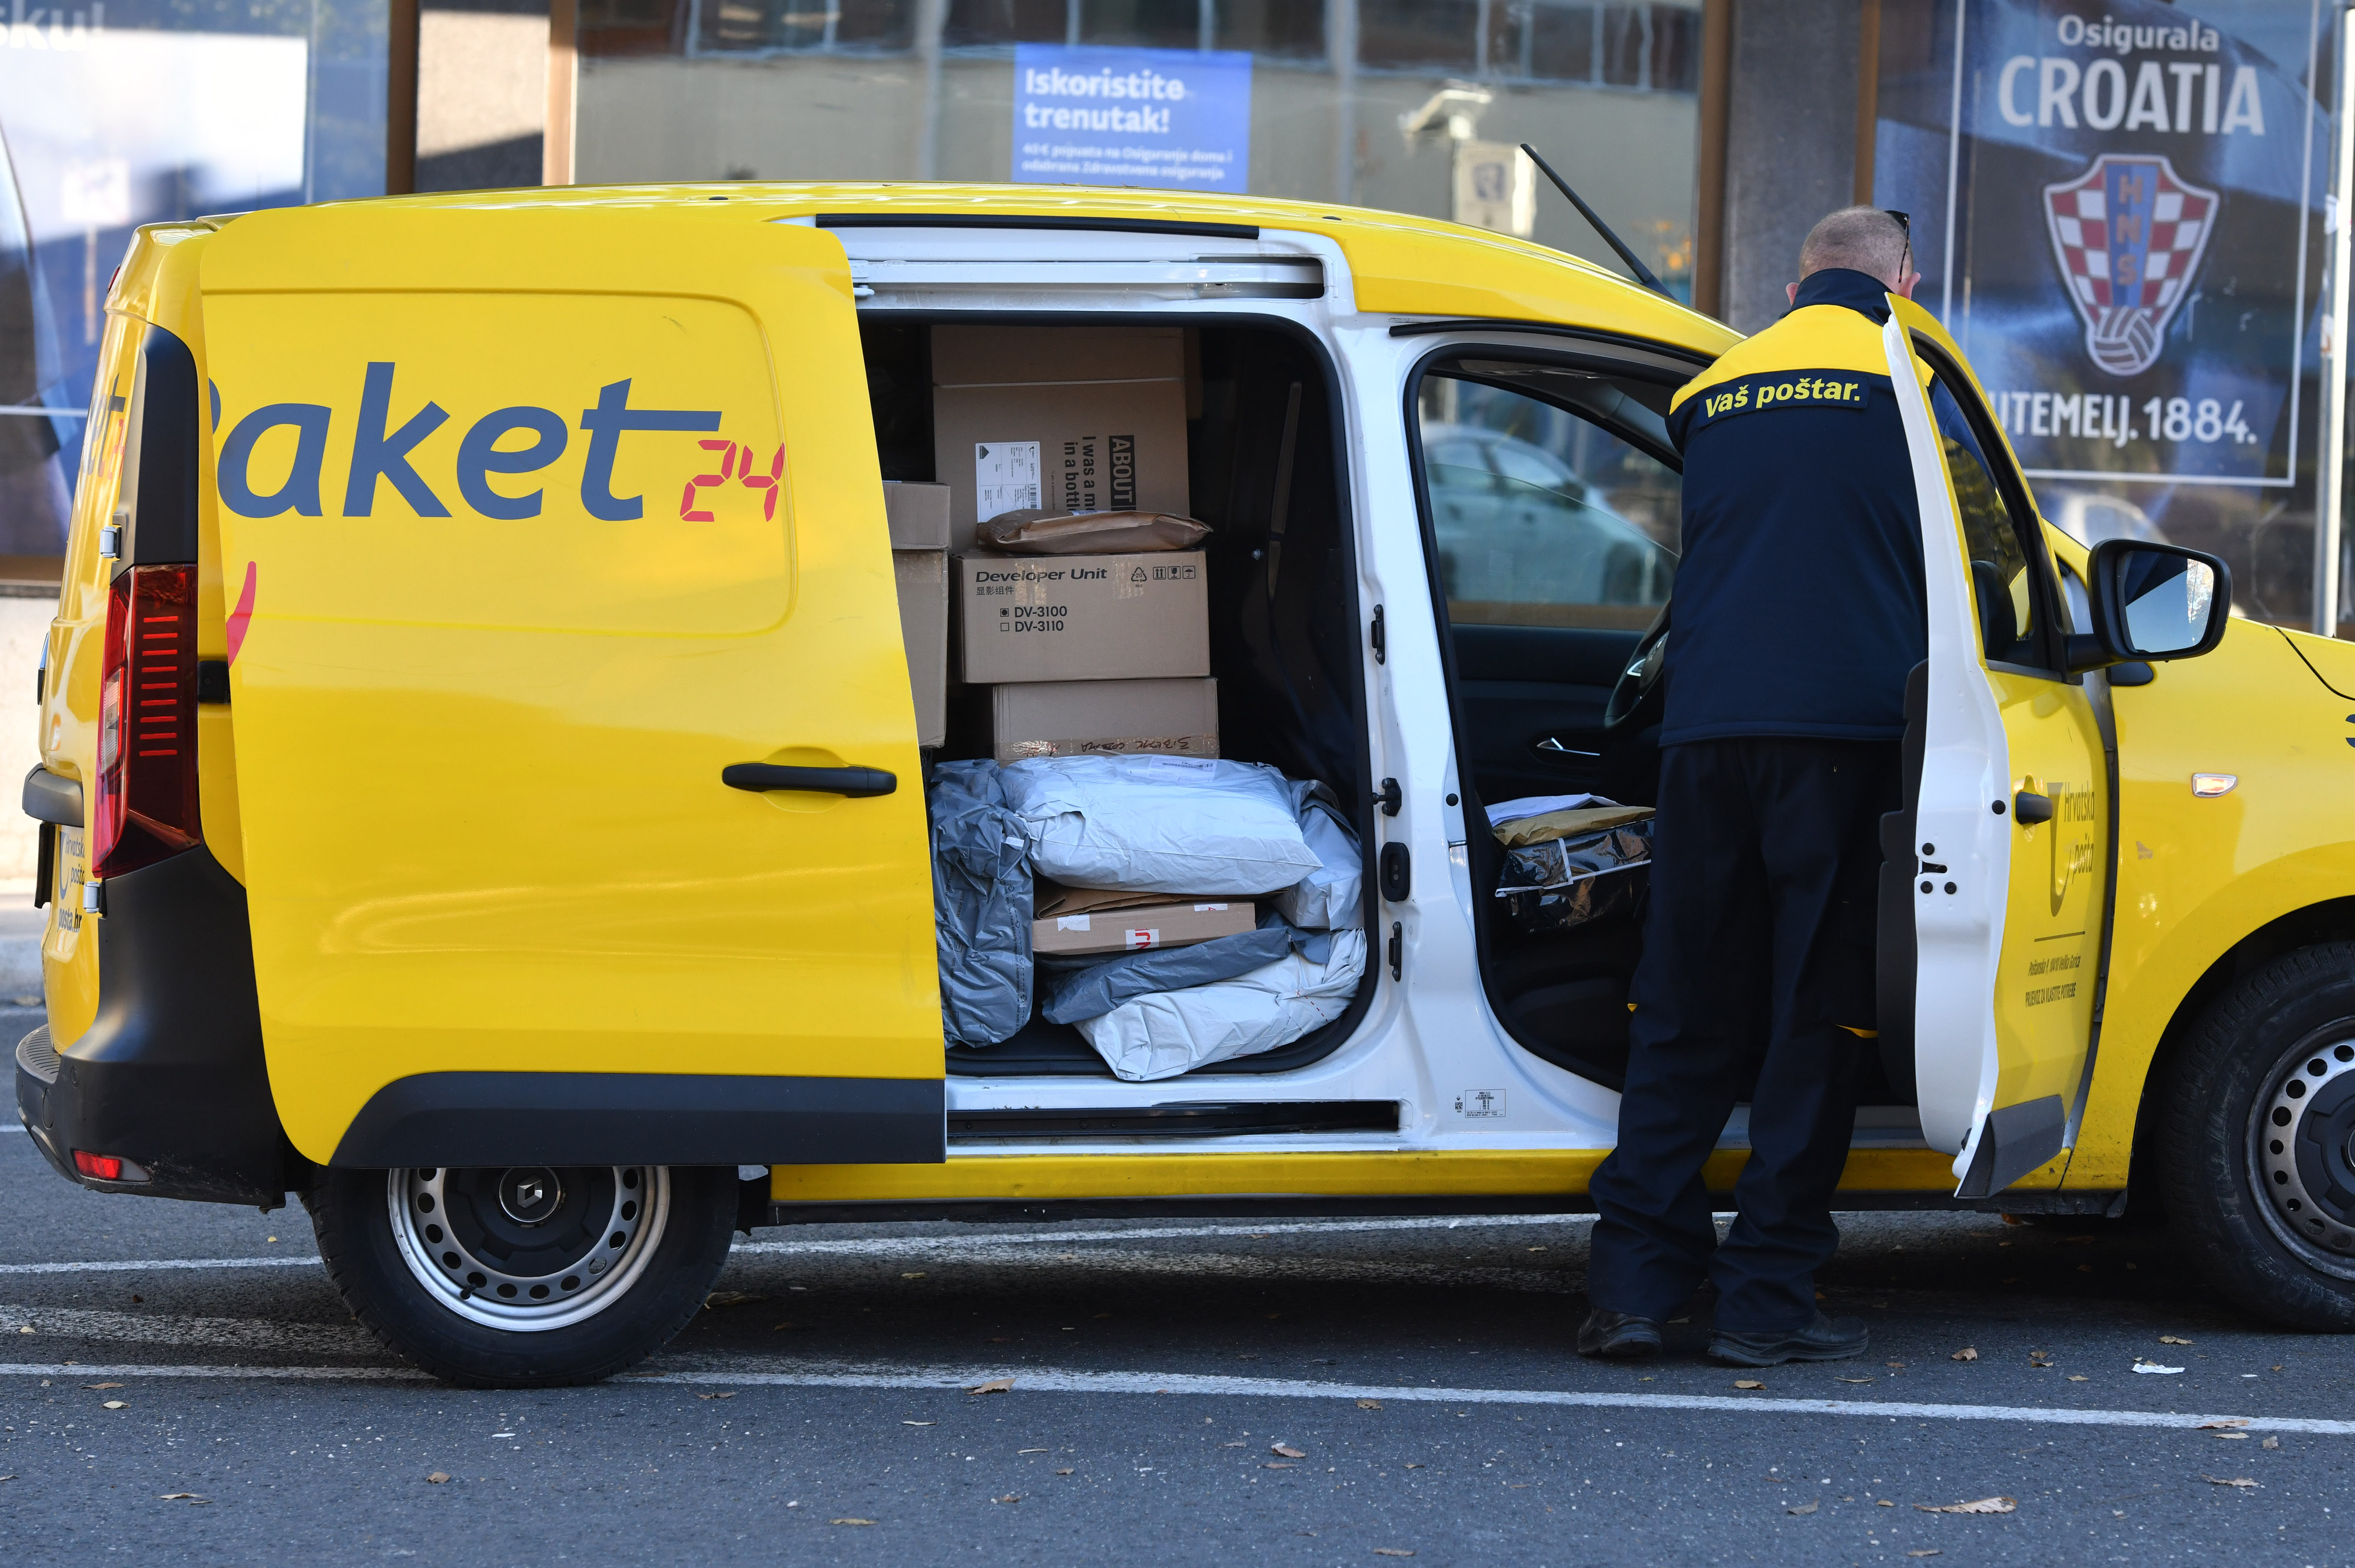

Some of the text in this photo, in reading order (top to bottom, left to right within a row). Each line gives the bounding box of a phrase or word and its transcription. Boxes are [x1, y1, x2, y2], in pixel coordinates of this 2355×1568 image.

[2058, 14, 2220, 54] Osigurala
[1025, 67, 1185, 100] Iskoristite
[1998, 55, 2266, 137] CROATIA
[1023, 102, 1170, 134] trenutak!
[1705, 377, 1860, 418] Vaš poštar.
[2142, 396, 2257, 445] 1884.
[207, 361, 722, 521] aket
[679, 439, 785, 522] 24
[1064, 442, 1079, 455] in
[1064, 459, 1076, 468] a
[1083, 444, 1095, 476] was
[1112, 437, 1132, 503] ABOUT
[1084, 480, 1095, 489] a
[976, 568, 1107, 583] Developer Unit
[976, 586, 1014, 596] 显影组件
[1014, 606, 1067, 617] DV-3100
[1015, 620, 1064, 632] DV-3110
[2064, 780, 2095, 823] Hrvatska
[2072, 833, 2094, 886] pošta
[57, 907, 82, 933] posta.hr
[2061, 982, 2077, 1000] POTREBE
